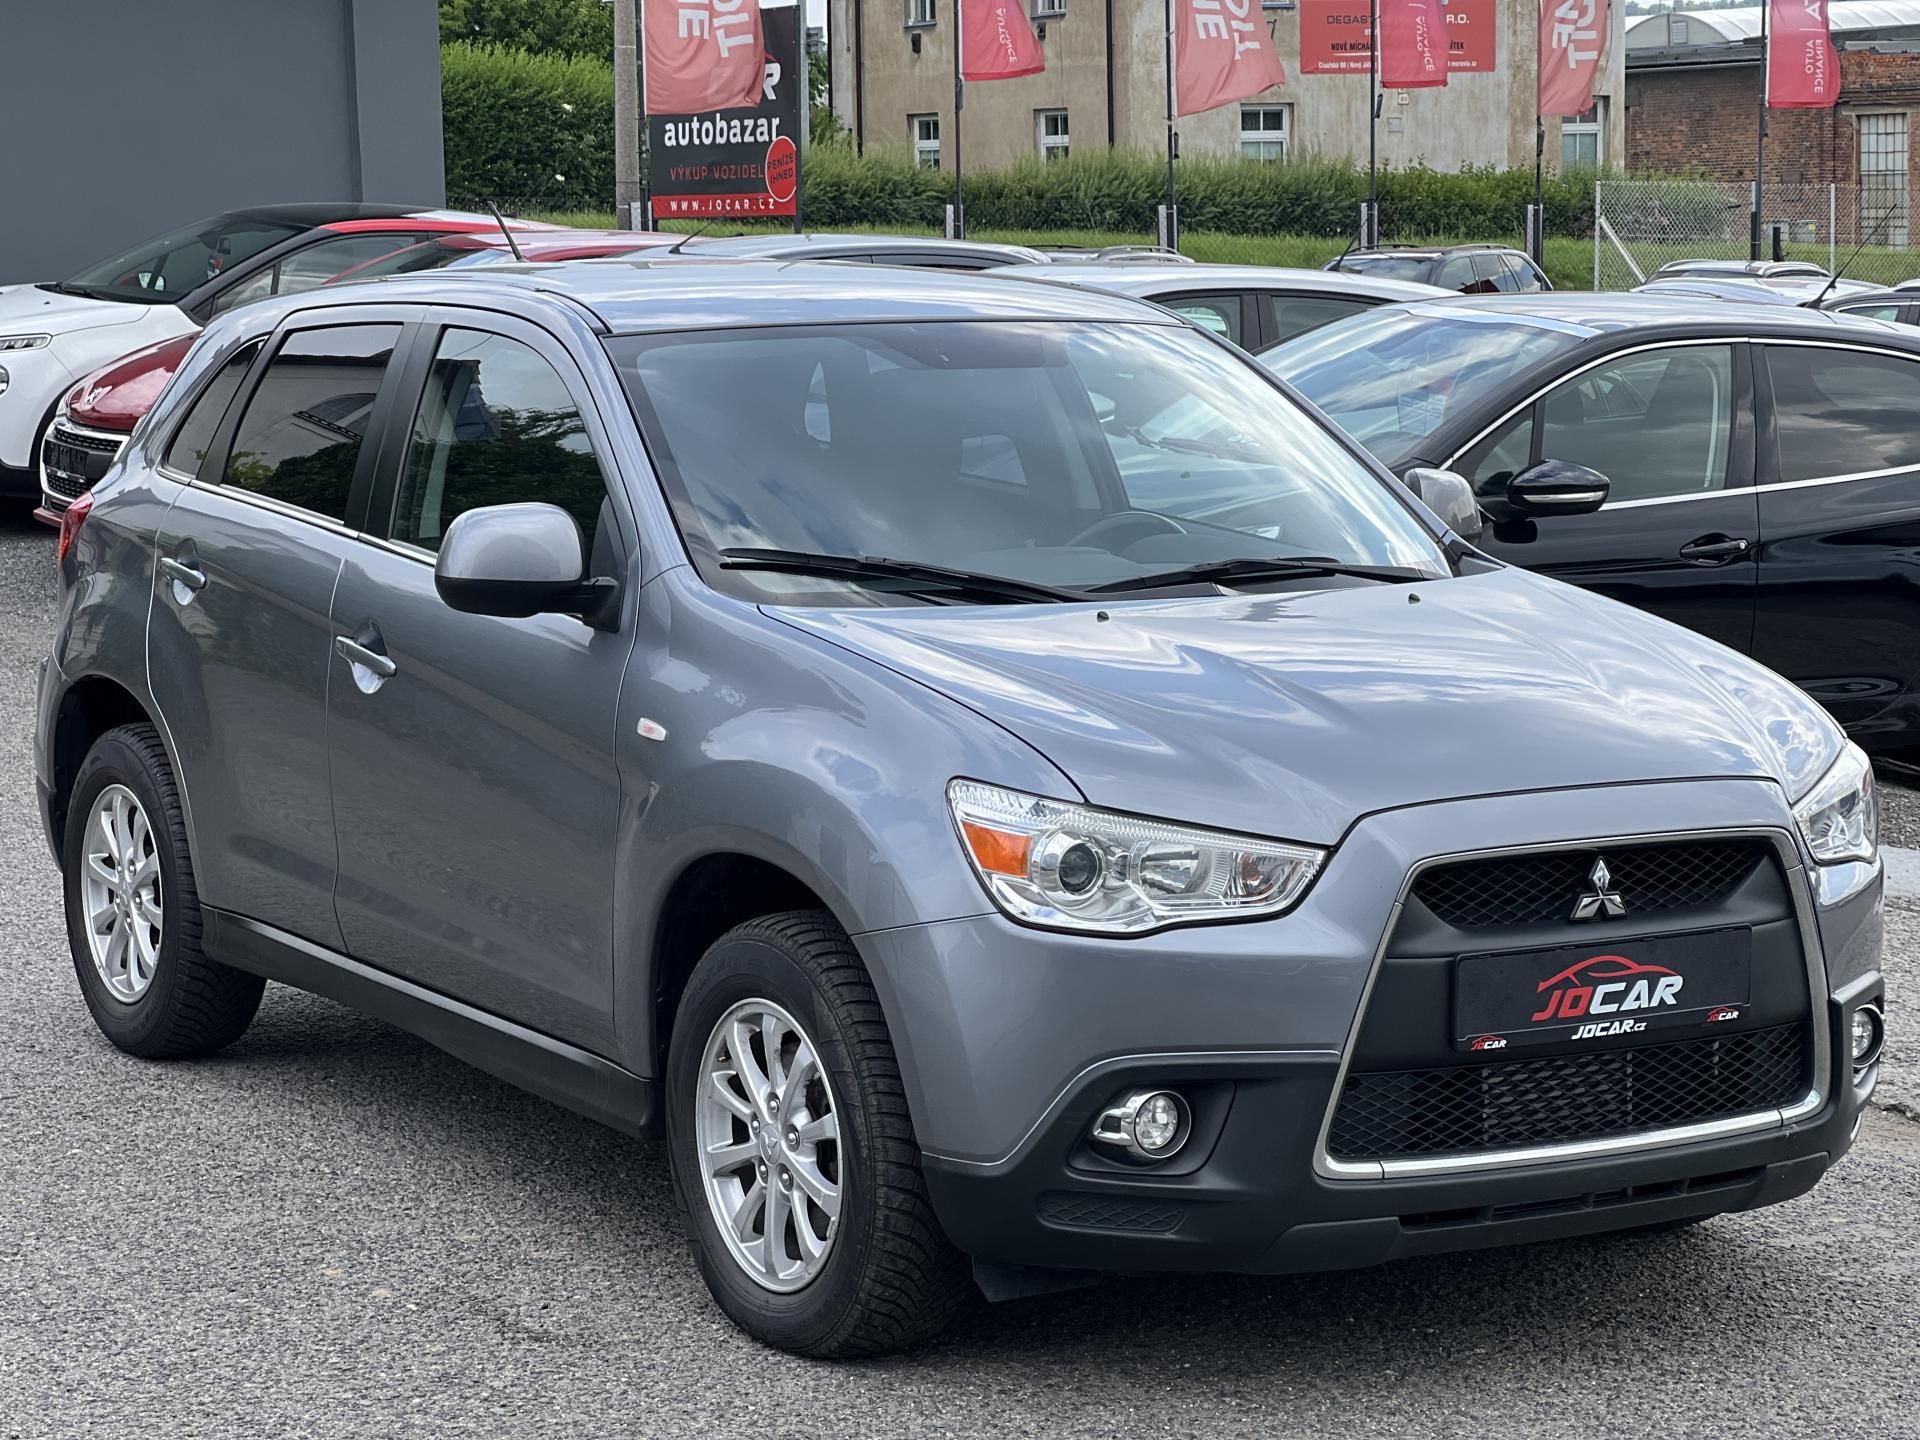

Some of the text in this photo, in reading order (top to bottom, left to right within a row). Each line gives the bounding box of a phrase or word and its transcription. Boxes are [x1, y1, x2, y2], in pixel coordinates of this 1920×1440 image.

[664, 113, 780, 147] autobazar
[767, 152, 794, 170] PENÍZE
[670, 164, 765, 182] VÝKUP VOZIDEL
[670, 197, 775, 211] WWW.JOCAR.CZ
[1531, 975, 1683, 1021] JOCAR
[1706, 1011, 1739, 1022] JOCAR
[1571, 1019, 1647, 1040] JOCAR.cz
[1471, 1039, 1507, 1051] JOCAR
